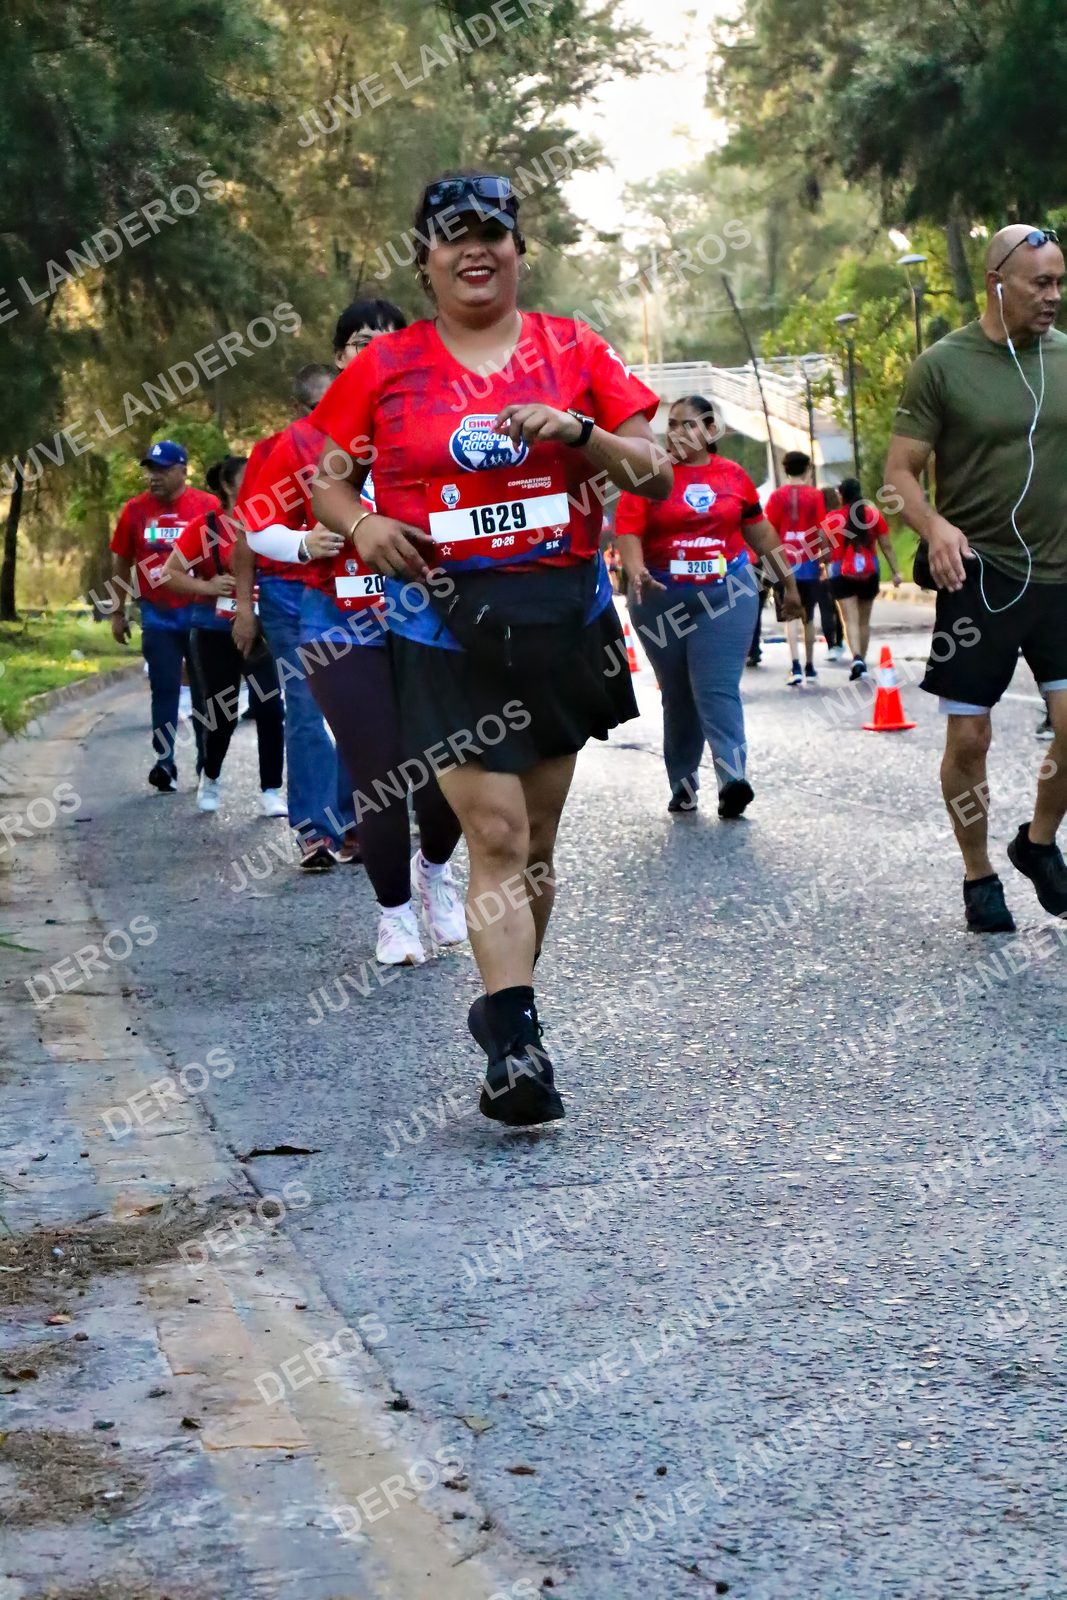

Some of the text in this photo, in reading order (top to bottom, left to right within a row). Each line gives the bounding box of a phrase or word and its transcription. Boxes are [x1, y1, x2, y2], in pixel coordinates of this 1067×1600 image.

[462, 440, 495, 451] Race
[470, 502, 526, 536] 1629
[687, 561, 713, 573] 3206
